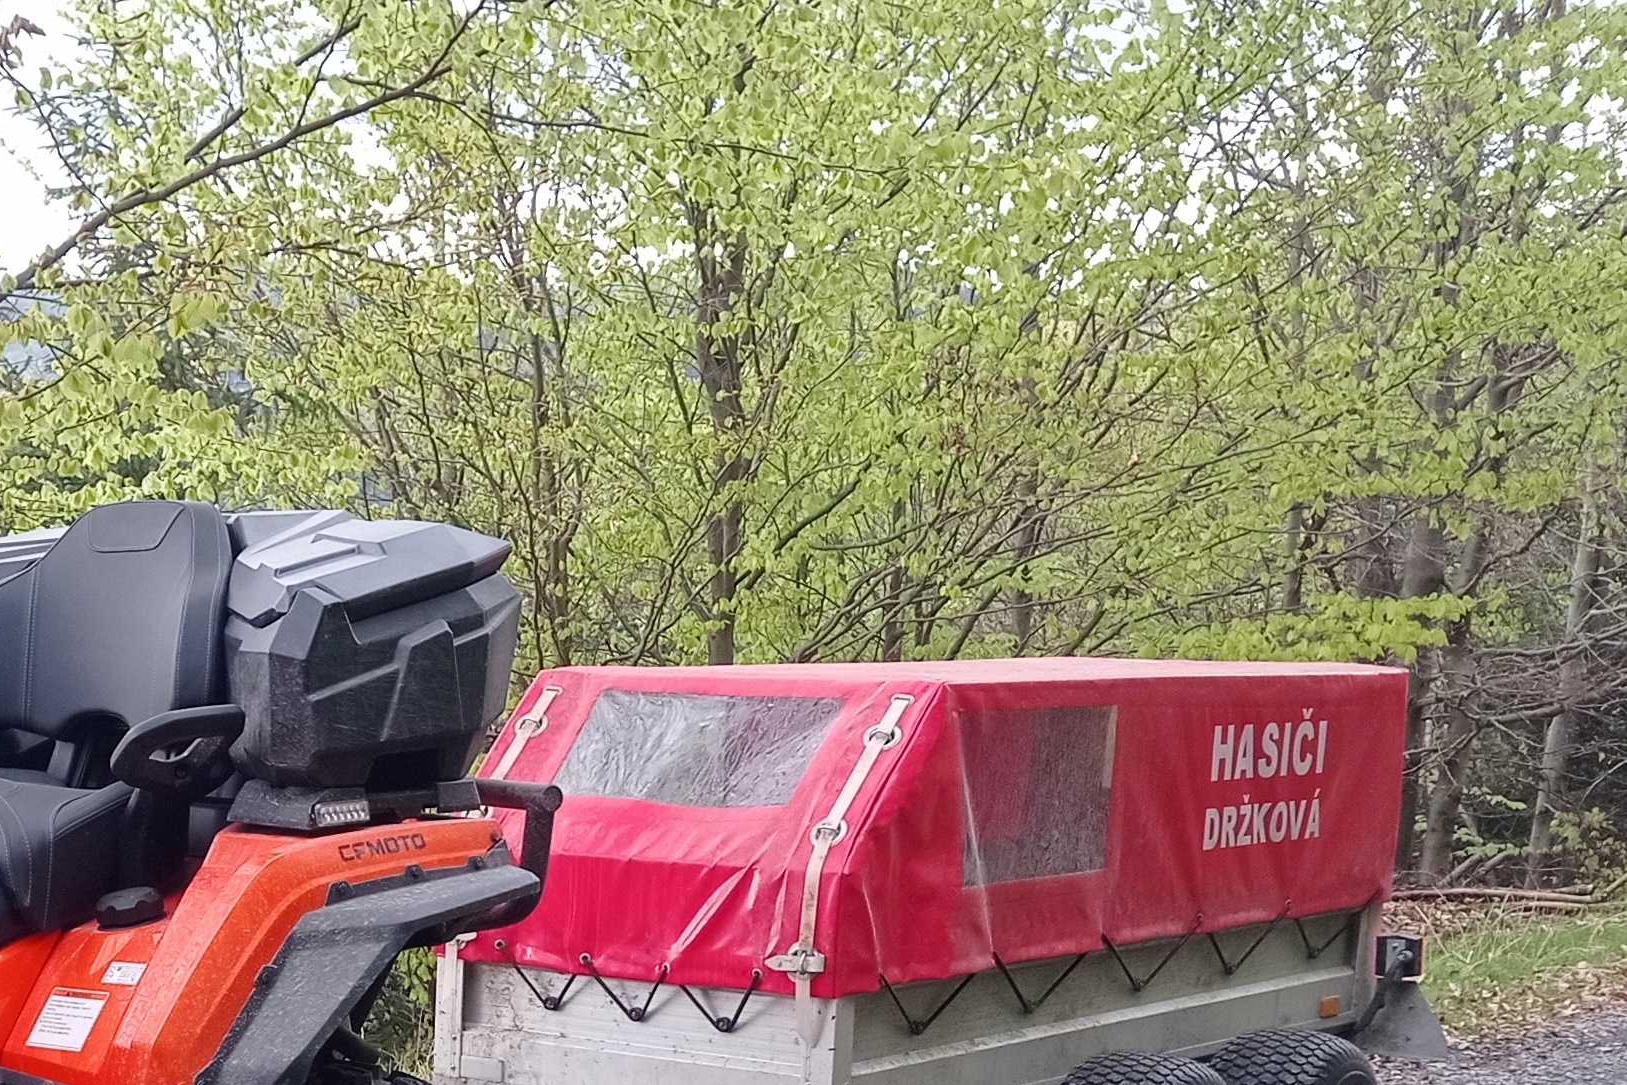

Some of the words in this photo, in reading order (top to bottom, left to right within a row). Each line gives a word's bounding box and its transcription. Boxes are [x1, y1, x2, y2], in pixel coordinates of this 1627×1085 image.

[1211, 707, 1328, 782] HASIČI
[338, 832, 427, 861] CFMOTO
[1203, 788, 1321, 850] DRŽKOVÁ
